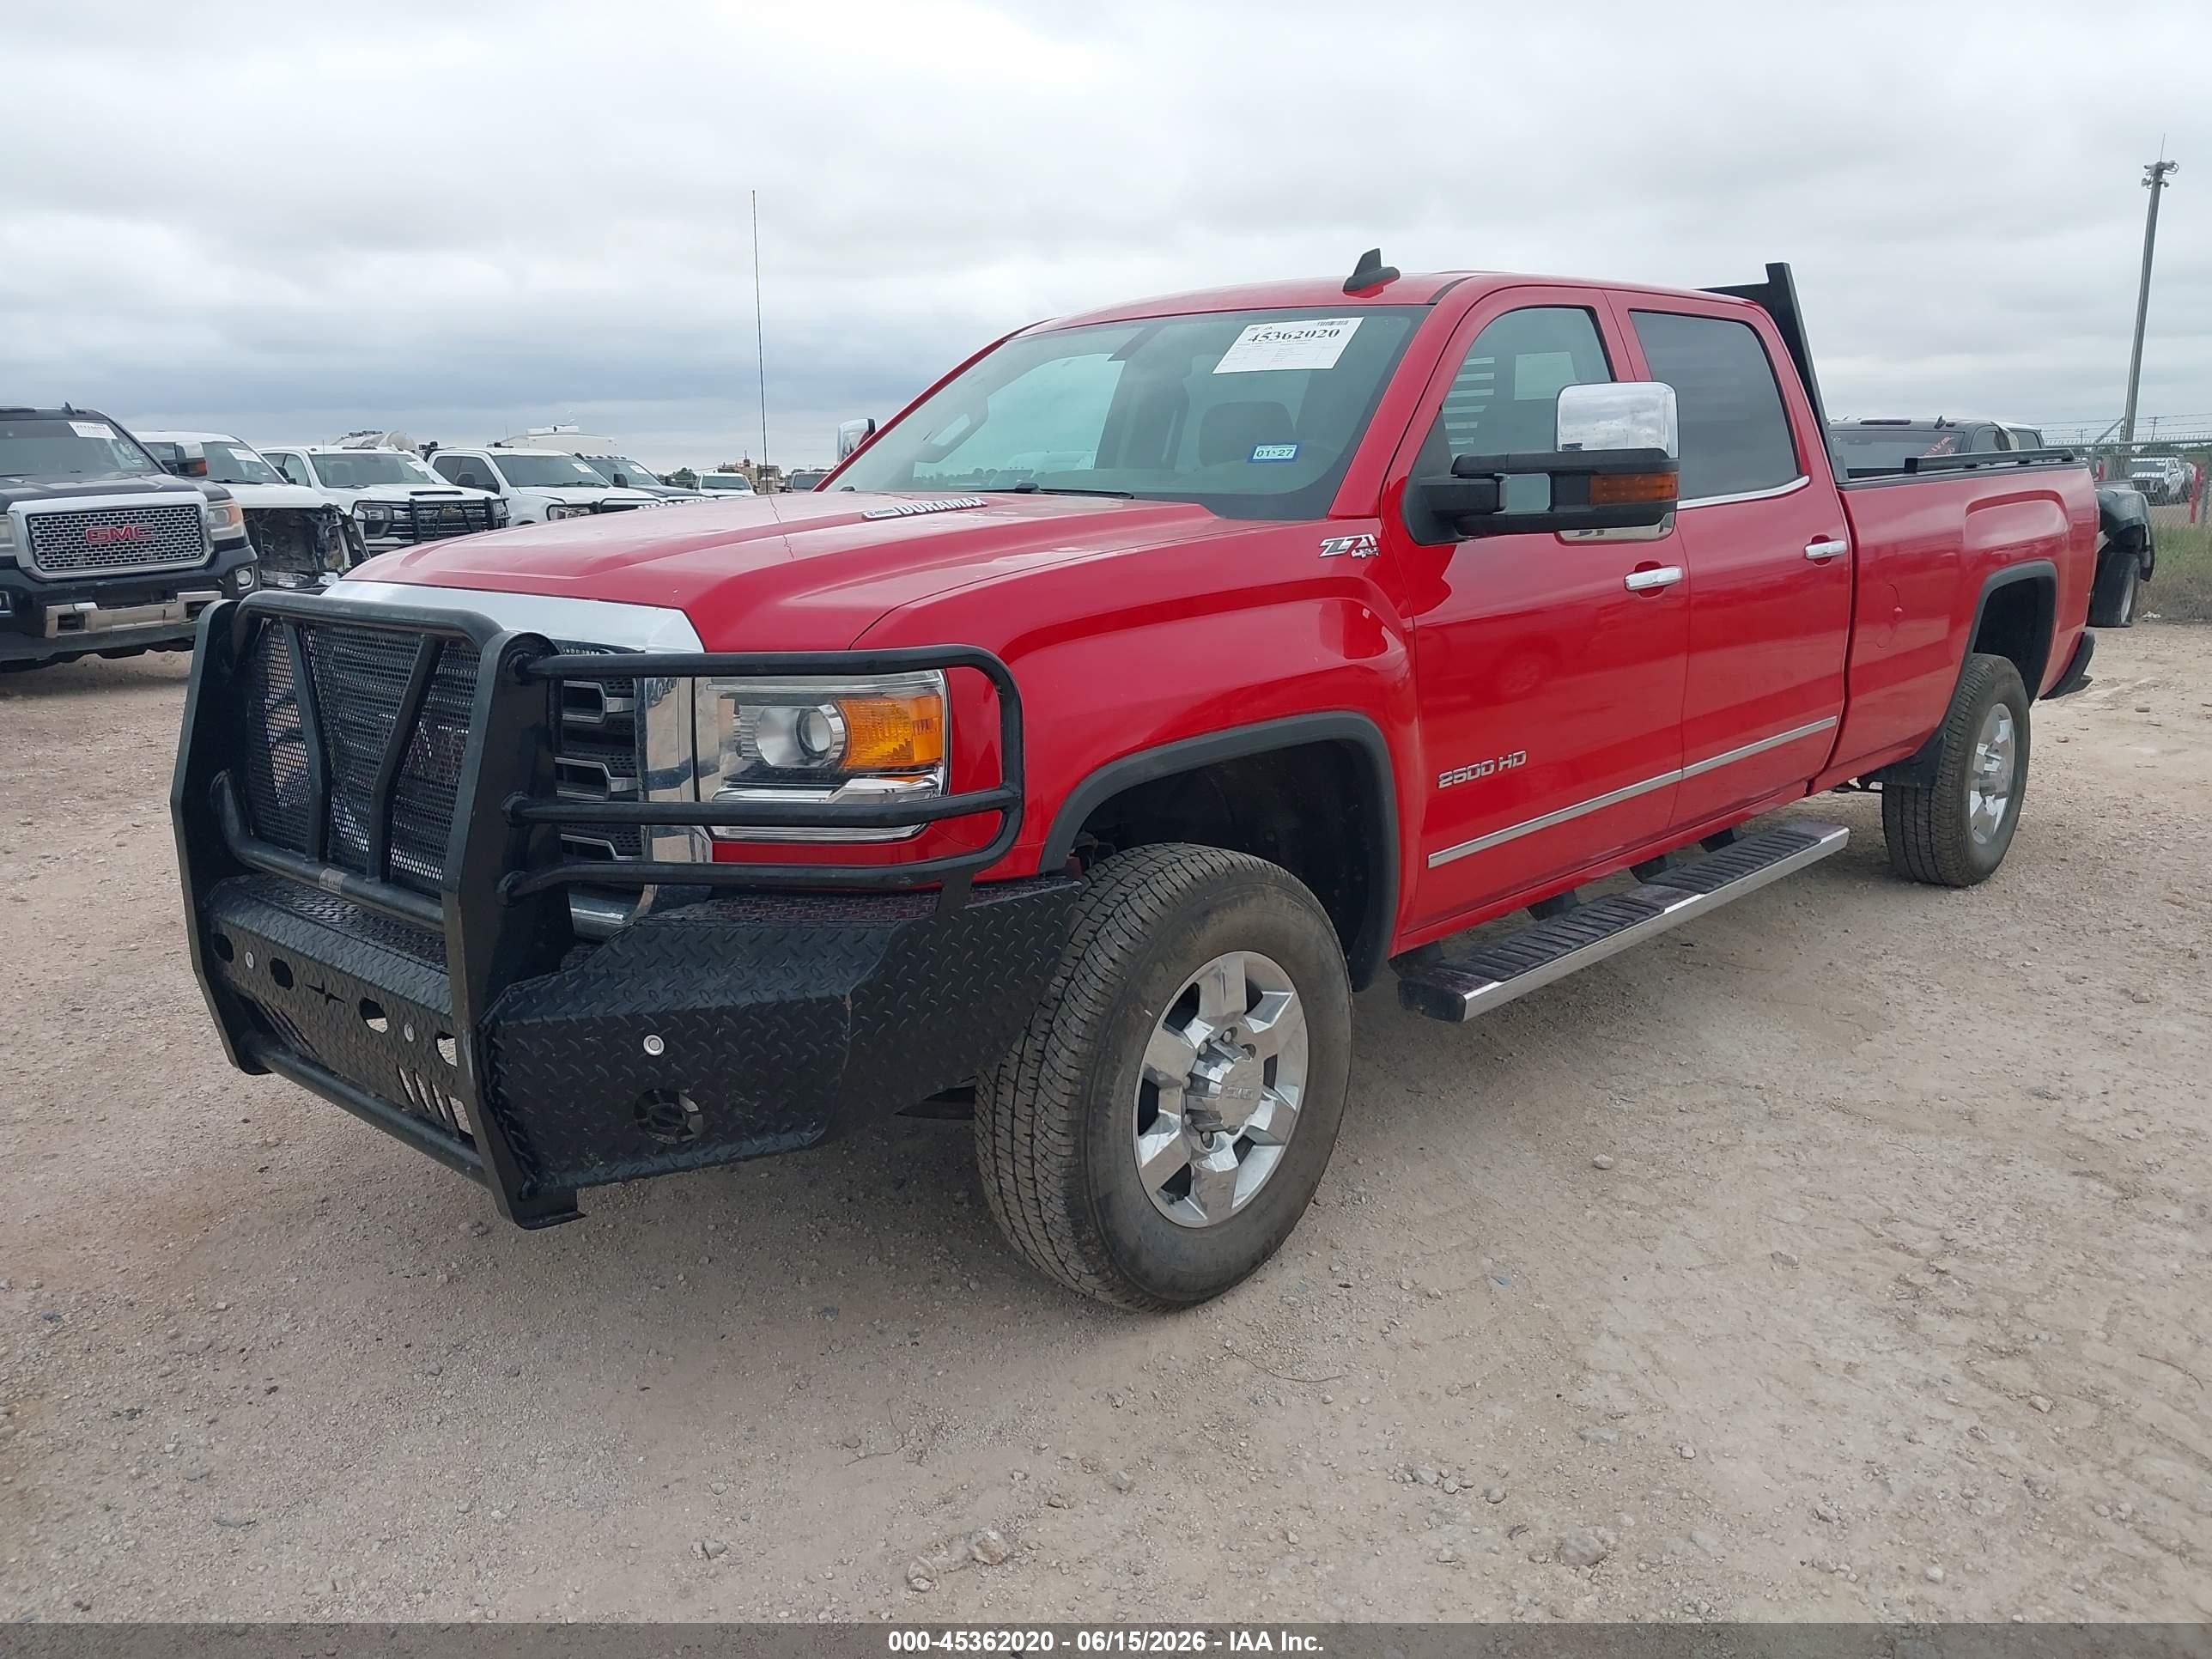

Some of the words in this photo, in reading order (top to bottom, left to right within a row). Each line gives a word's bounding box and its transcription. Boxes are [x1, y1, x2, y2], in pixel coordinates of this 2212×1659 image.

[1248, 328, 1340, 343] 45362020
[896, 496, 987, 515] DURAMAX
[85, 522, 155, 544] GMC
[1319, 533, 1377, 557] Z71
[1438, 759, 1494, 789] 2500
[1498, 750, 1527, 771] HD
